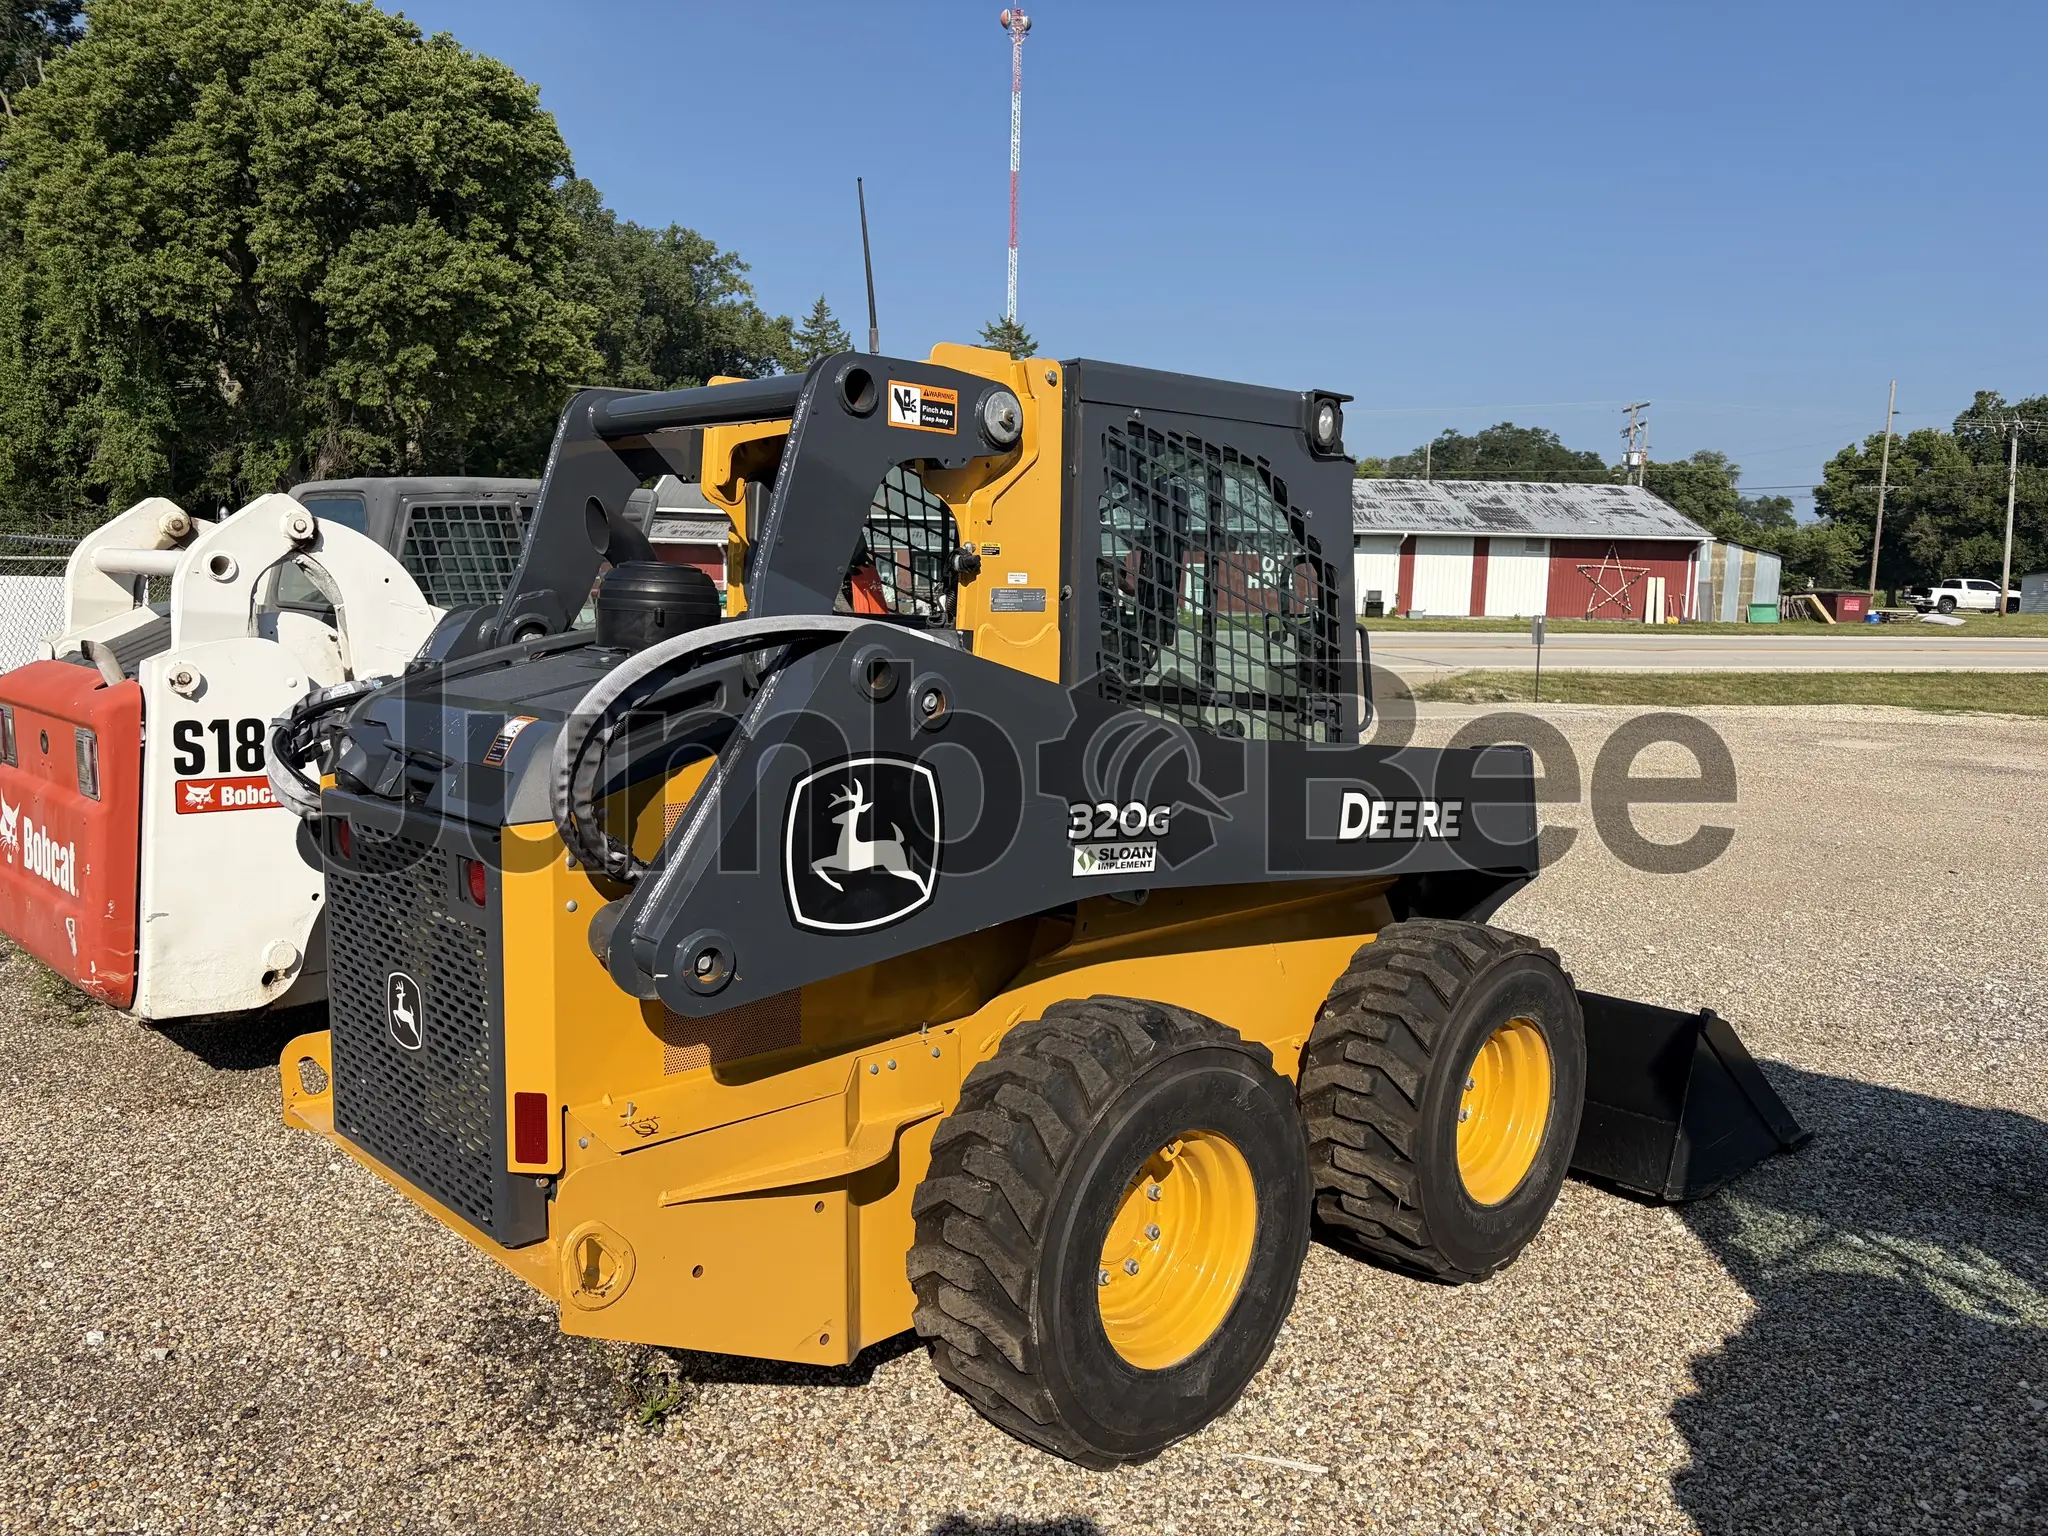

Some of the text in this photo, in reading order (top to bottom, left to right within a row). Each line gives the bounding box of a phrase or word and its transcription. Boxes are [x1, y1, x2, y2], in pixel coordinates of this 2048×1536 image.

[928, 390, 955, 401] WARNING
[922, 405, 953, 416] Pinch Area
[921, 414, 949, 426] Keep Away
[1068, 801, 1171, 839] 320G
[1339, 792, 1463, 840] DEERE
[23, 815, 76, 897] Bobcat
[1098, 846, 1154, 861] SLOAN
[1097, 860, 1153, 871] IMPLEMENT
